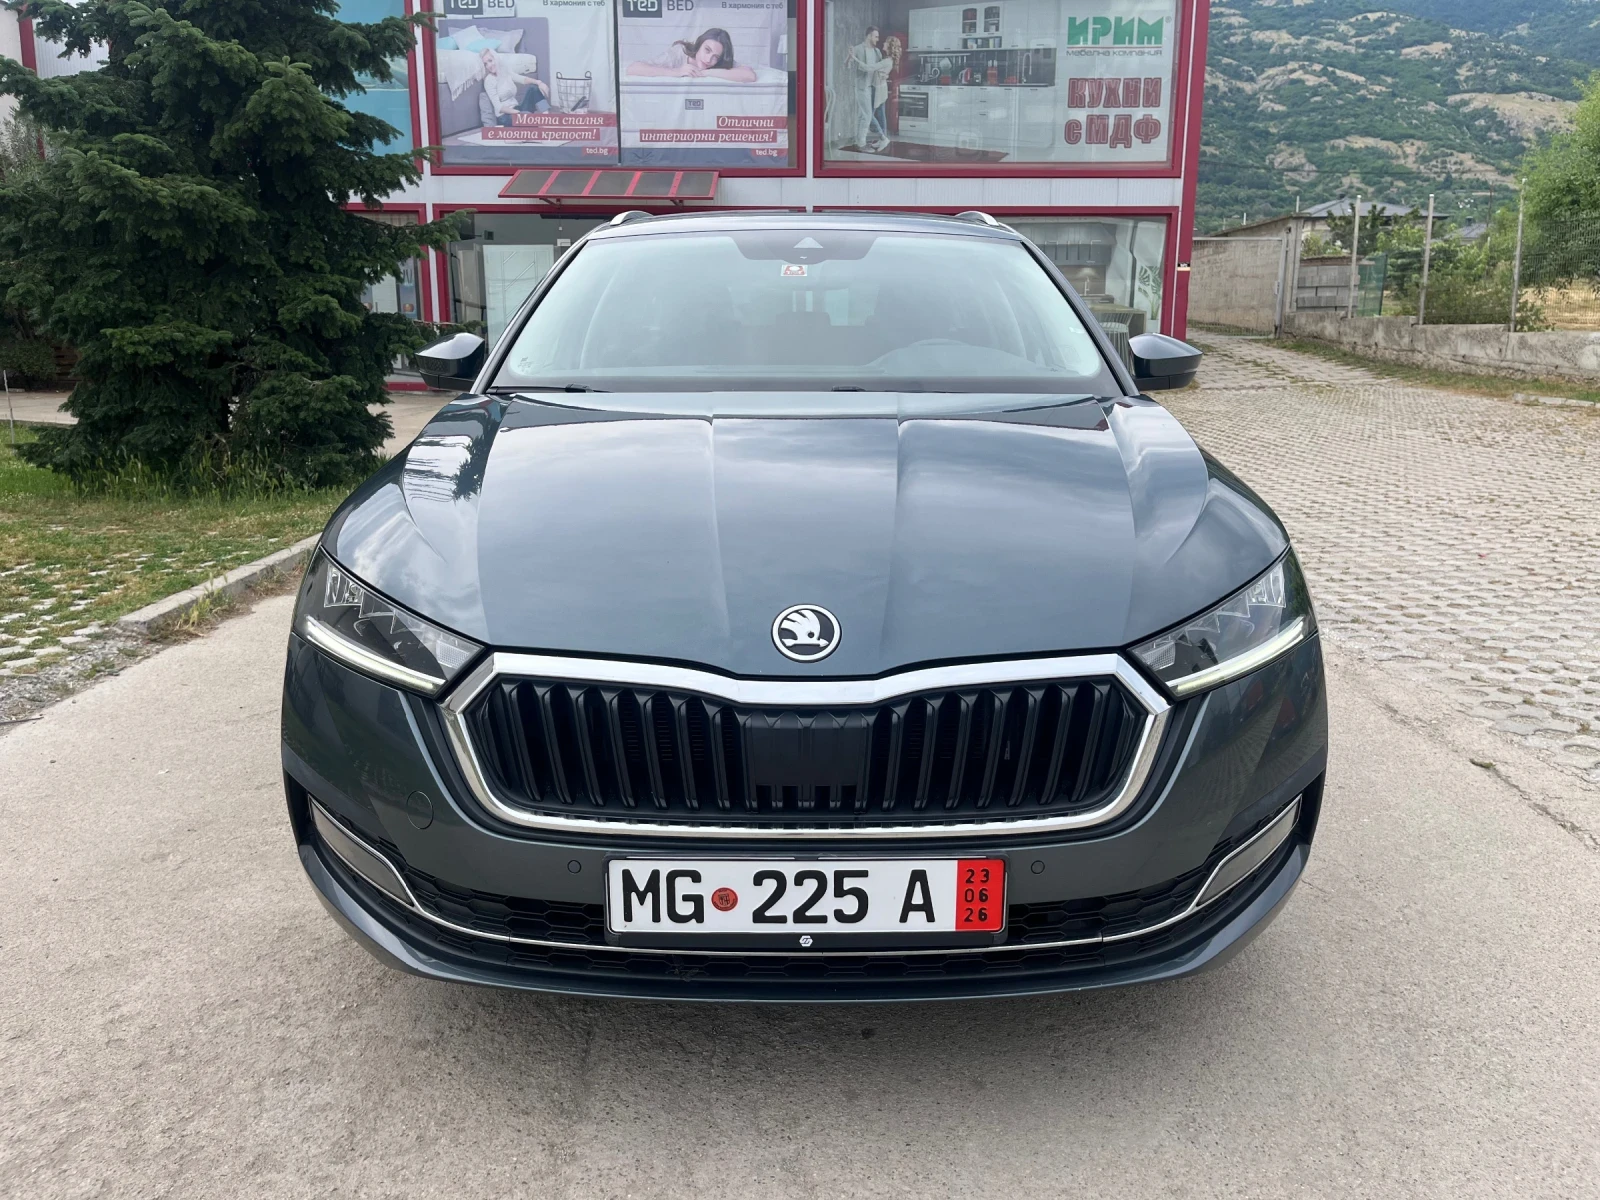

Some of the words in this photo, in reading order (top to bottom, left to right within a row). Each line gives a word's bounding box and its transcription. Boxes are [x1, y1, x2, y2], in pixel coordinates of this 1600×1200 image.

[487, 0, 515, 8] BED
[667, 0, 695, 11] BED
[722, 1, 727, 9] В
[1067, 16, 1164, 45] ИРИМ
[1066, 49, 1110, 57] мебелна
[1113, 49, 1162, 57] компания
[1067, 77, 1162, 108] КУХНИ
[515, 114, 559, 125] Моята
[562, 115, 604, 125] спалня
[718, 116, 774, 128] Отлични
[488, 129, 494, 139] е
[497, 129, 538, 139] моята
[541, 128, 596, 141] крепост!
[641, 131, 715, 143] интериорни
[718, 131, 774, 143] решения!
[1064, 119, 1082, 145] с
[1085, 114, 1161, 149] МДФ
[585, 147, 609, 155] ted.bg
[755, 148, 778, 157] ted.bg
[965, 868, 990, 884] 23
[621, 868, 705, 924] MG
[752, 869, 869, 924] 225
[898, 869, 936, 924] A
[964, 888, 989, 903] 06
[963, 907, 988, 922] 26
